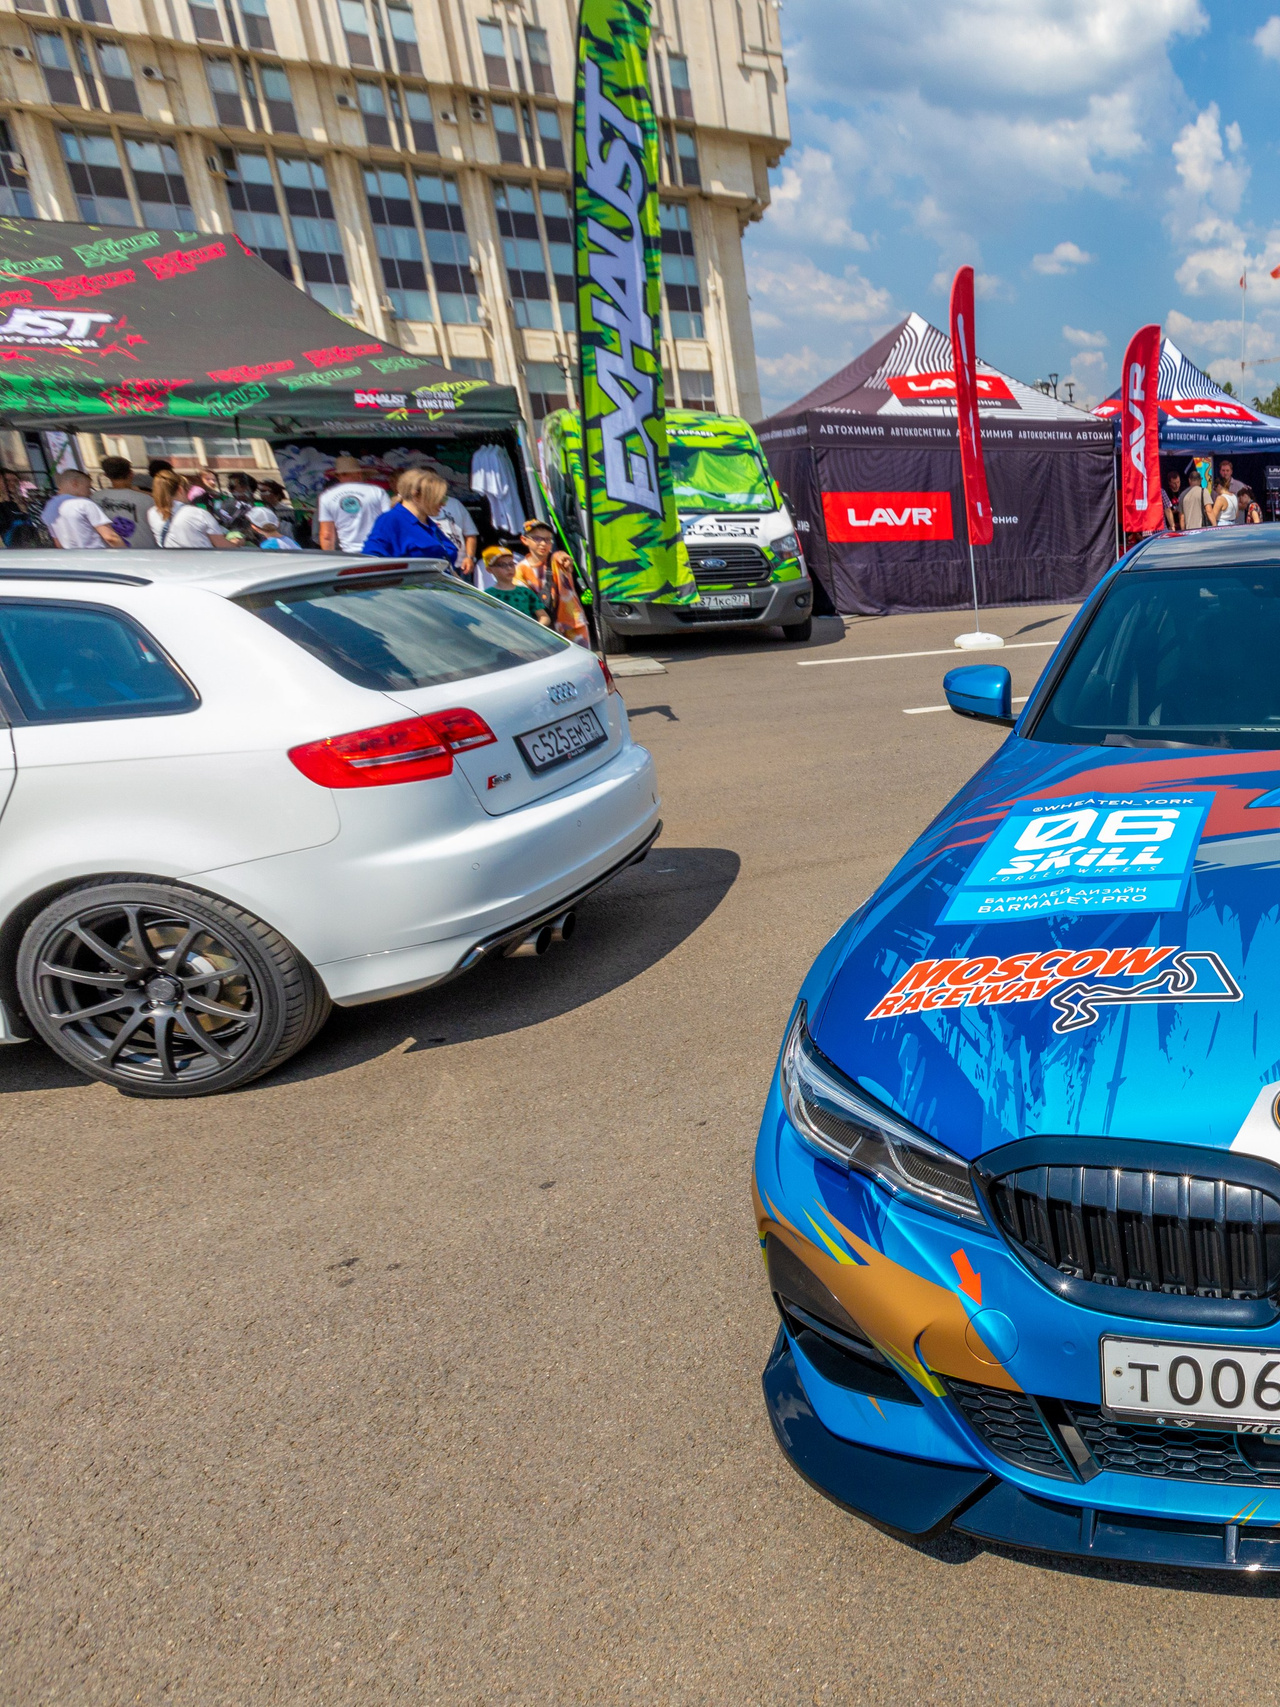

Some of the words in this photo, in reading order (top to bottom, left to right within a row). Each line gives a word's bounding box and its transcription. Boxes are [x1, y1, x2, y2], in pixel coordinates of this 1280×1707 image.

[585, 60, 664, 518] EXHAUST
[1174, 404, 1240, 416] LAVR
[819, 424, 885, 437] АВТОХИМИЯ
[890, 426, 952, 438] АВТОКОСМЕТИКА
[1018, 430, 1073, 440] АВТОКОСМЕТИКА
[1128, 362, 1149, 511] LAVR
[1166, 432, 1210, 441] АВТОКОСМЕТИКА
[1212, 434, 1253, 443] АВТОХИМИЯ
[848, 508, 933, 527] LAVR
[686, 524, 760, 536] HAUST
[579, 713, 596, 734] 57
[1032, 798, 1194, 813] @WHEATEN_YORK
[1013, 808, 1181, 851] 06
[996, 845, 1164, 875] SKILL
[988, 868, 1065, 882] FORGED
[1078, 865, 1157, 875] WHEELS
[977, 894, 1148, 914] BARMALEY.PRO
[984, 887, 1070, 904] БАРМАЛЕЙ
[1076, 886, 1148, 896] ДИЗАЙН
[885, 945, 1181, 997] MOSCOW
[865, 978, 1064, 1021] RACEWAY
